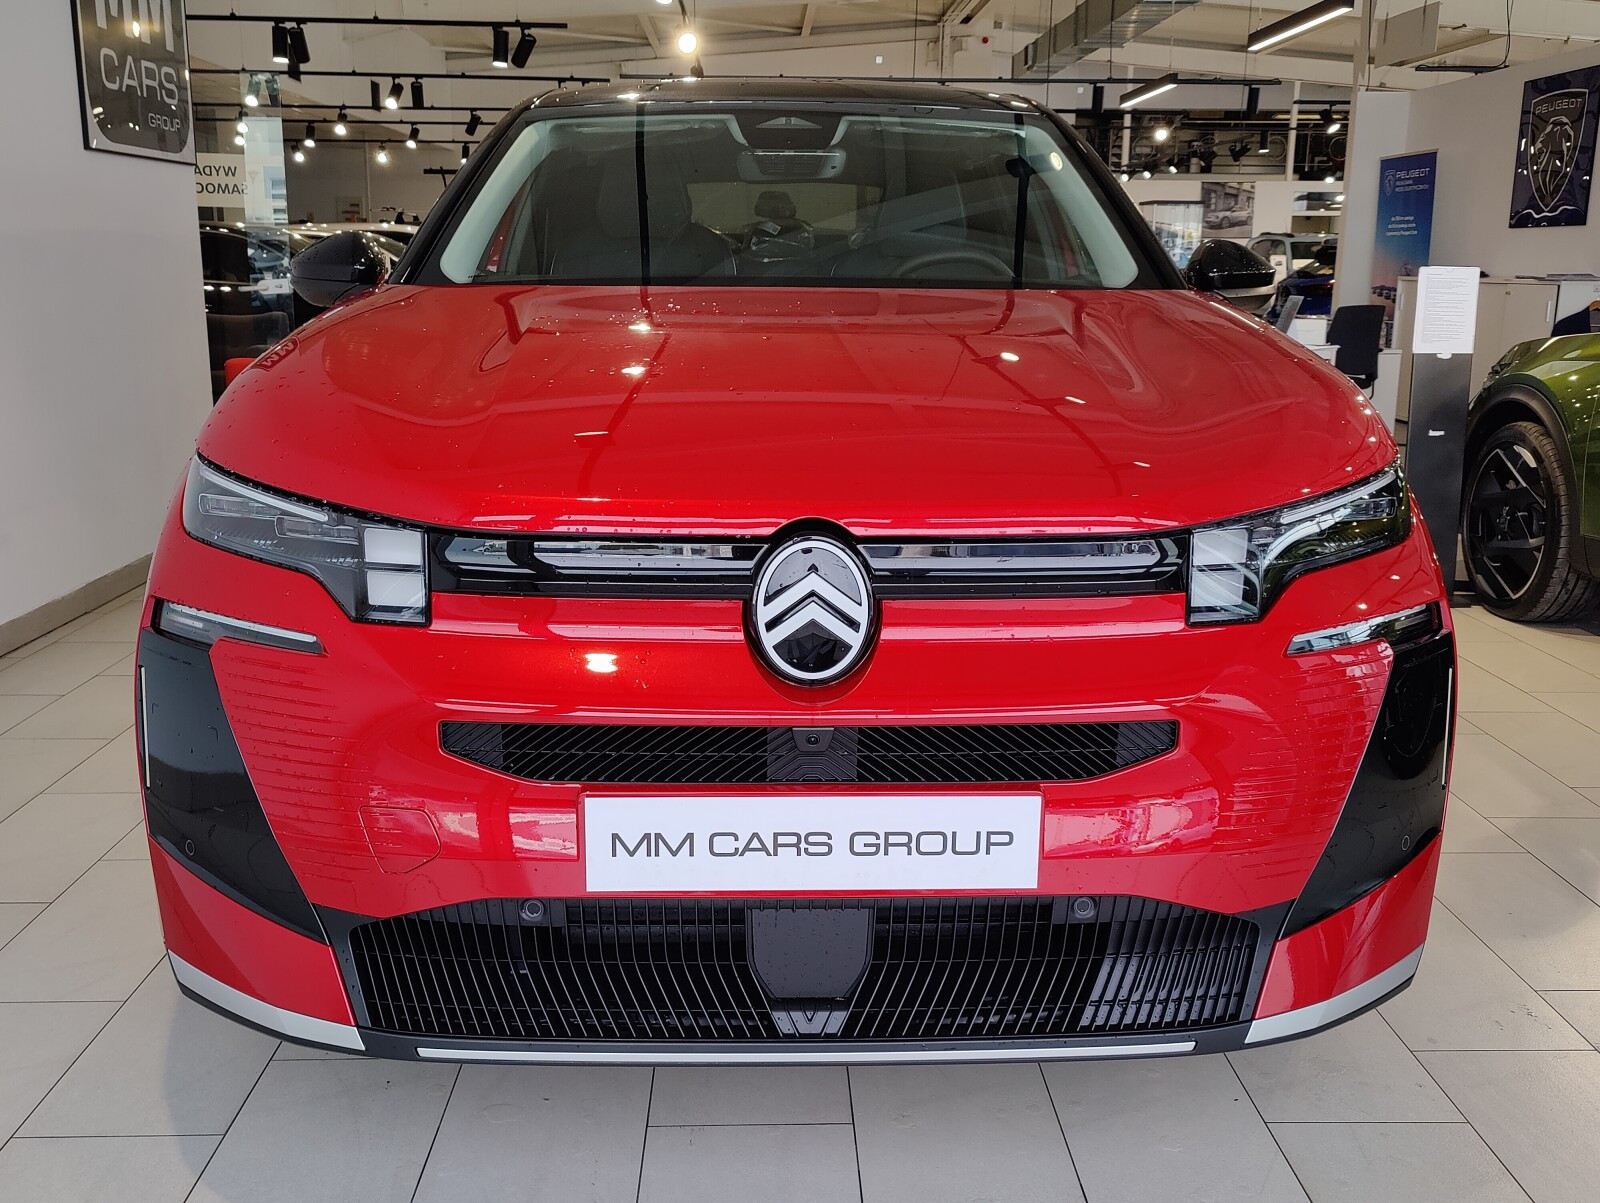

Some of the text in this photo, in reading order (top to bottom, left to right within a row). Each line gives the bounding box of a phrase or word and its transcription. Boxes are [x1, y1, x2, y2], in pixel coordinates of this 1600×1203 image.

[100, 47, 179, 105] CARS
[1535, 98, 1583, 116] PEUGEOT
[148, 113, 181, 132] GROUP
[1396, 168, 1430, 179] PEUGEOT
[611, 830, 1014, 858] MM CARS GROUP
